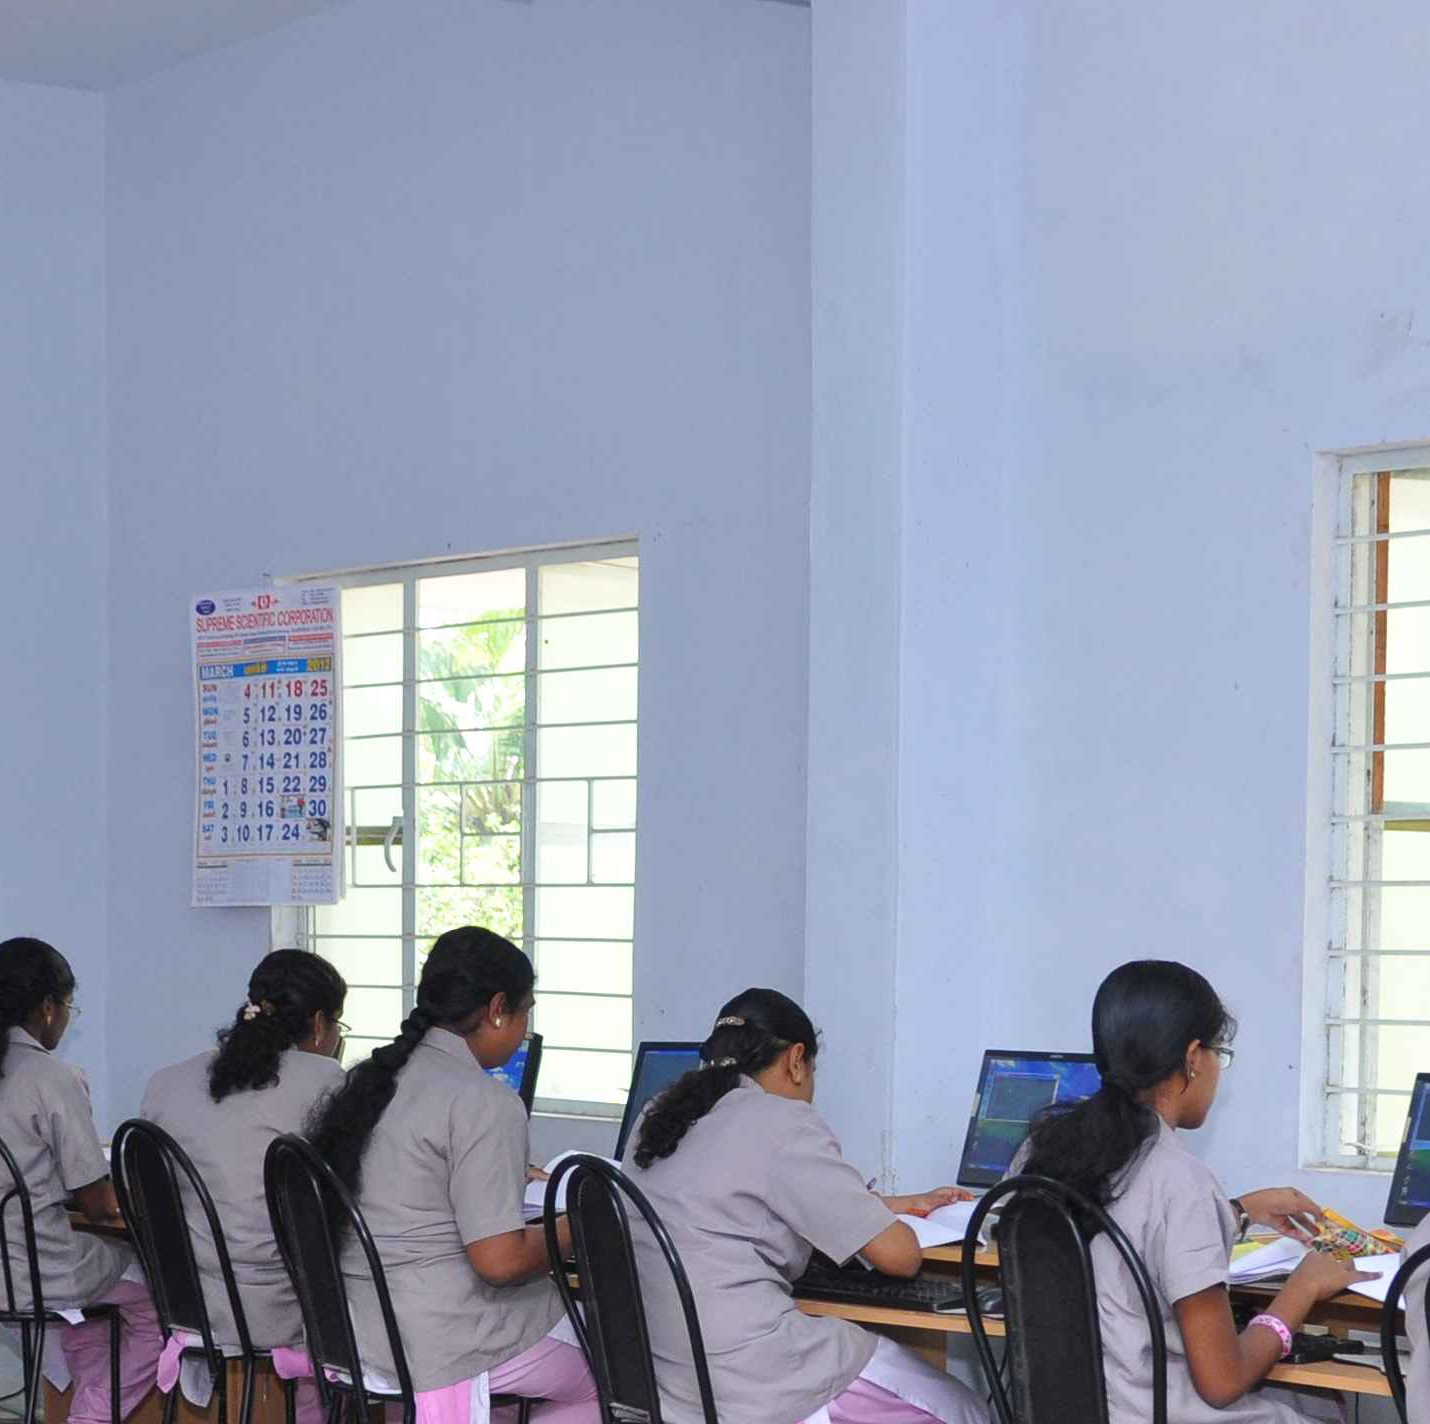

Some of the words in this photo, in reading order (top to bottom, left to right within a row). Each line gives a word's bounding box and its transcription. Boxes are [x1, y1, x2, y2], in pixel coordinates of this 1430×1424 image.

[196, 614, 235, 632] SUPREME
[236, 611, 276, 629] SCIENTIFIC
[277, 608, 334, 626] CORPORATION
[202, 664, 234, 679] MARCH
[244, 684, 251, 699] 4
[261, 681, 275, 698] 11
[285, 680, 303, 697] 18
[310, 680, 328, 696] 25
[243, 707, 250, 724] 5
[260, 705, 276, 722] 12
[285, 704, 302, 721] 19
[309, 703, 328, 720] 26
[242, 731, 249, 747] 6
[259, 729, 275, 746] 13
[283, 728, 302, 745] 20
[309, 727, 326, 744] 27
[242, 754, 249, 771] 7
[259, 753, 275, 769] 14
[283, 752, 300, 769] 21
[309, 751, 327, 768] 28
[223, 780, 228, 795] 1
[241, 778, 248, 794] 8
[258, 777, 275, 793] 15
[282, 776, 301, 793] 22
[309, 775, 327, 792] 29
[222, 803, 229, 819] 2
[240, 801, 247, 817] 9
[258, 801, 274, 817] 16
[308, 799, 326, 816] 30
[221, 827, 228, 843] 3
[237, 825, 250, 842] 10
[257, 825, 273, 840] 17
[282, 824, 300, 840] 24
